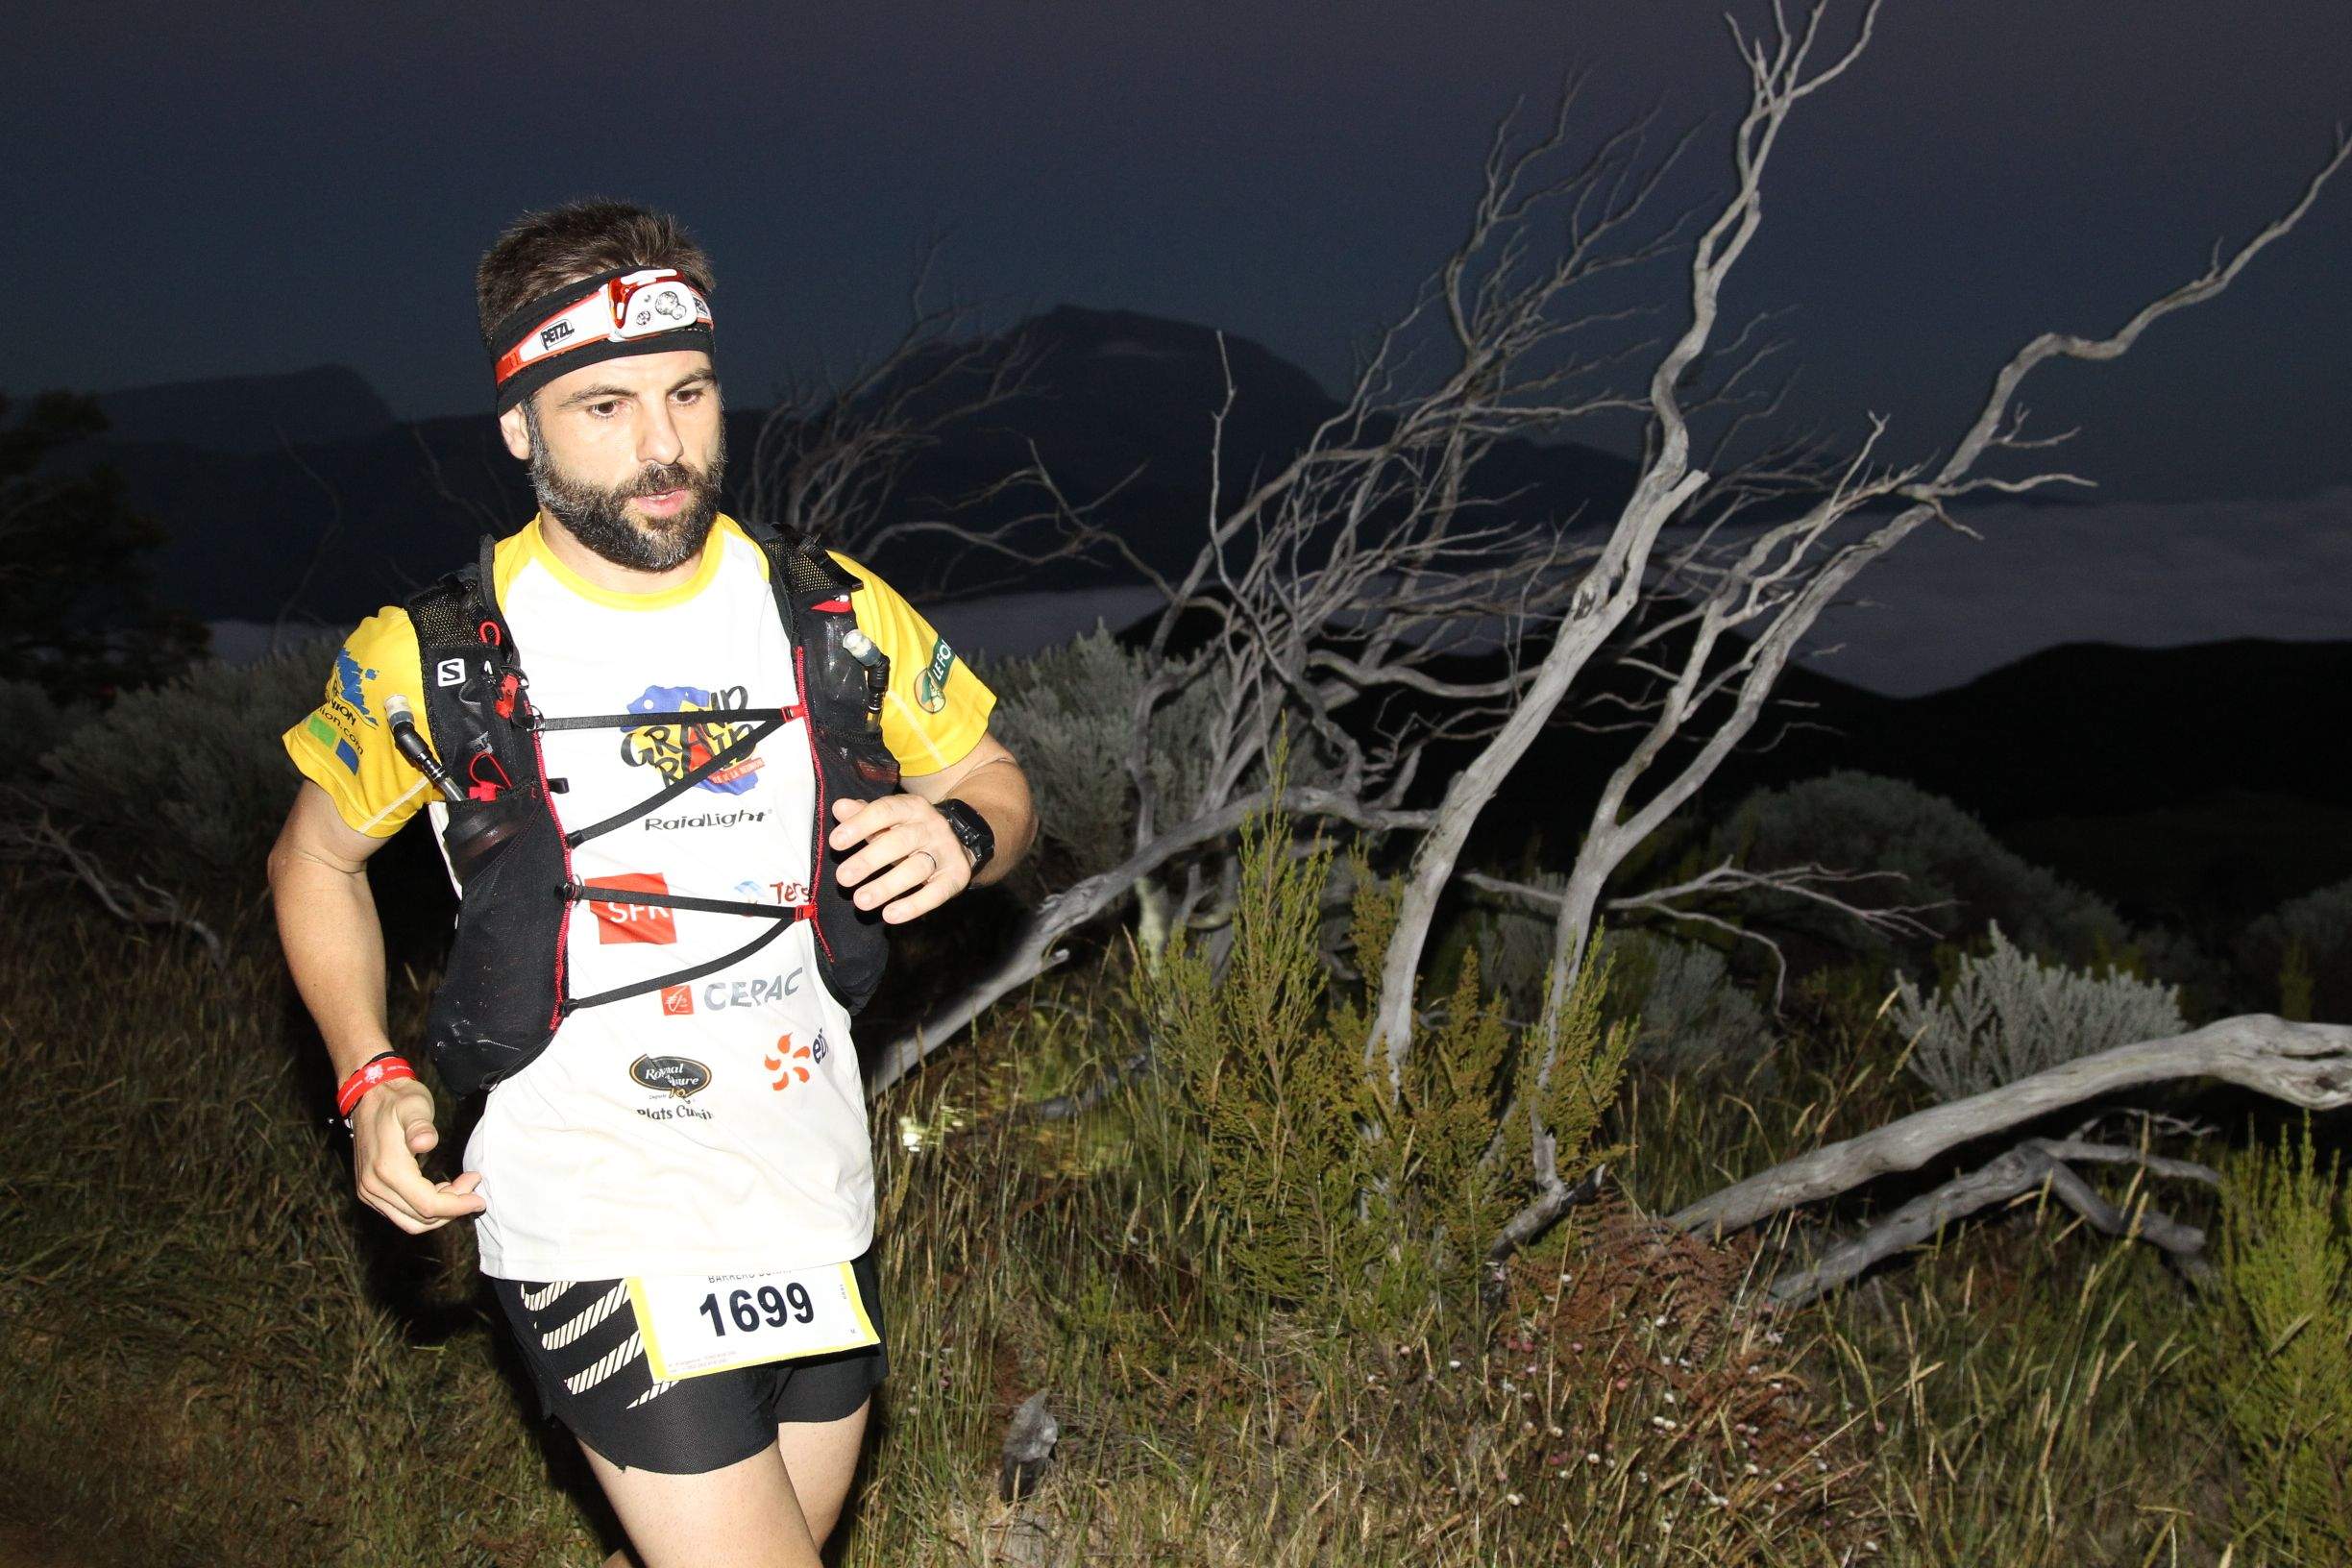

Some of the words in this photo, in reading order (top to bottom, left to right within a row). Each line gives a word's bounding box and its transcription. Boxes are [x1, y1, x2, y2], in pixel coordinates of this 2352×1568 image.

[540, 321, 575, 351] PETZL
[938, 640, 953, 668] FO
[703, 967, 803, 1011] CEPAC
[699, 1282, 814, 1336] 1699
